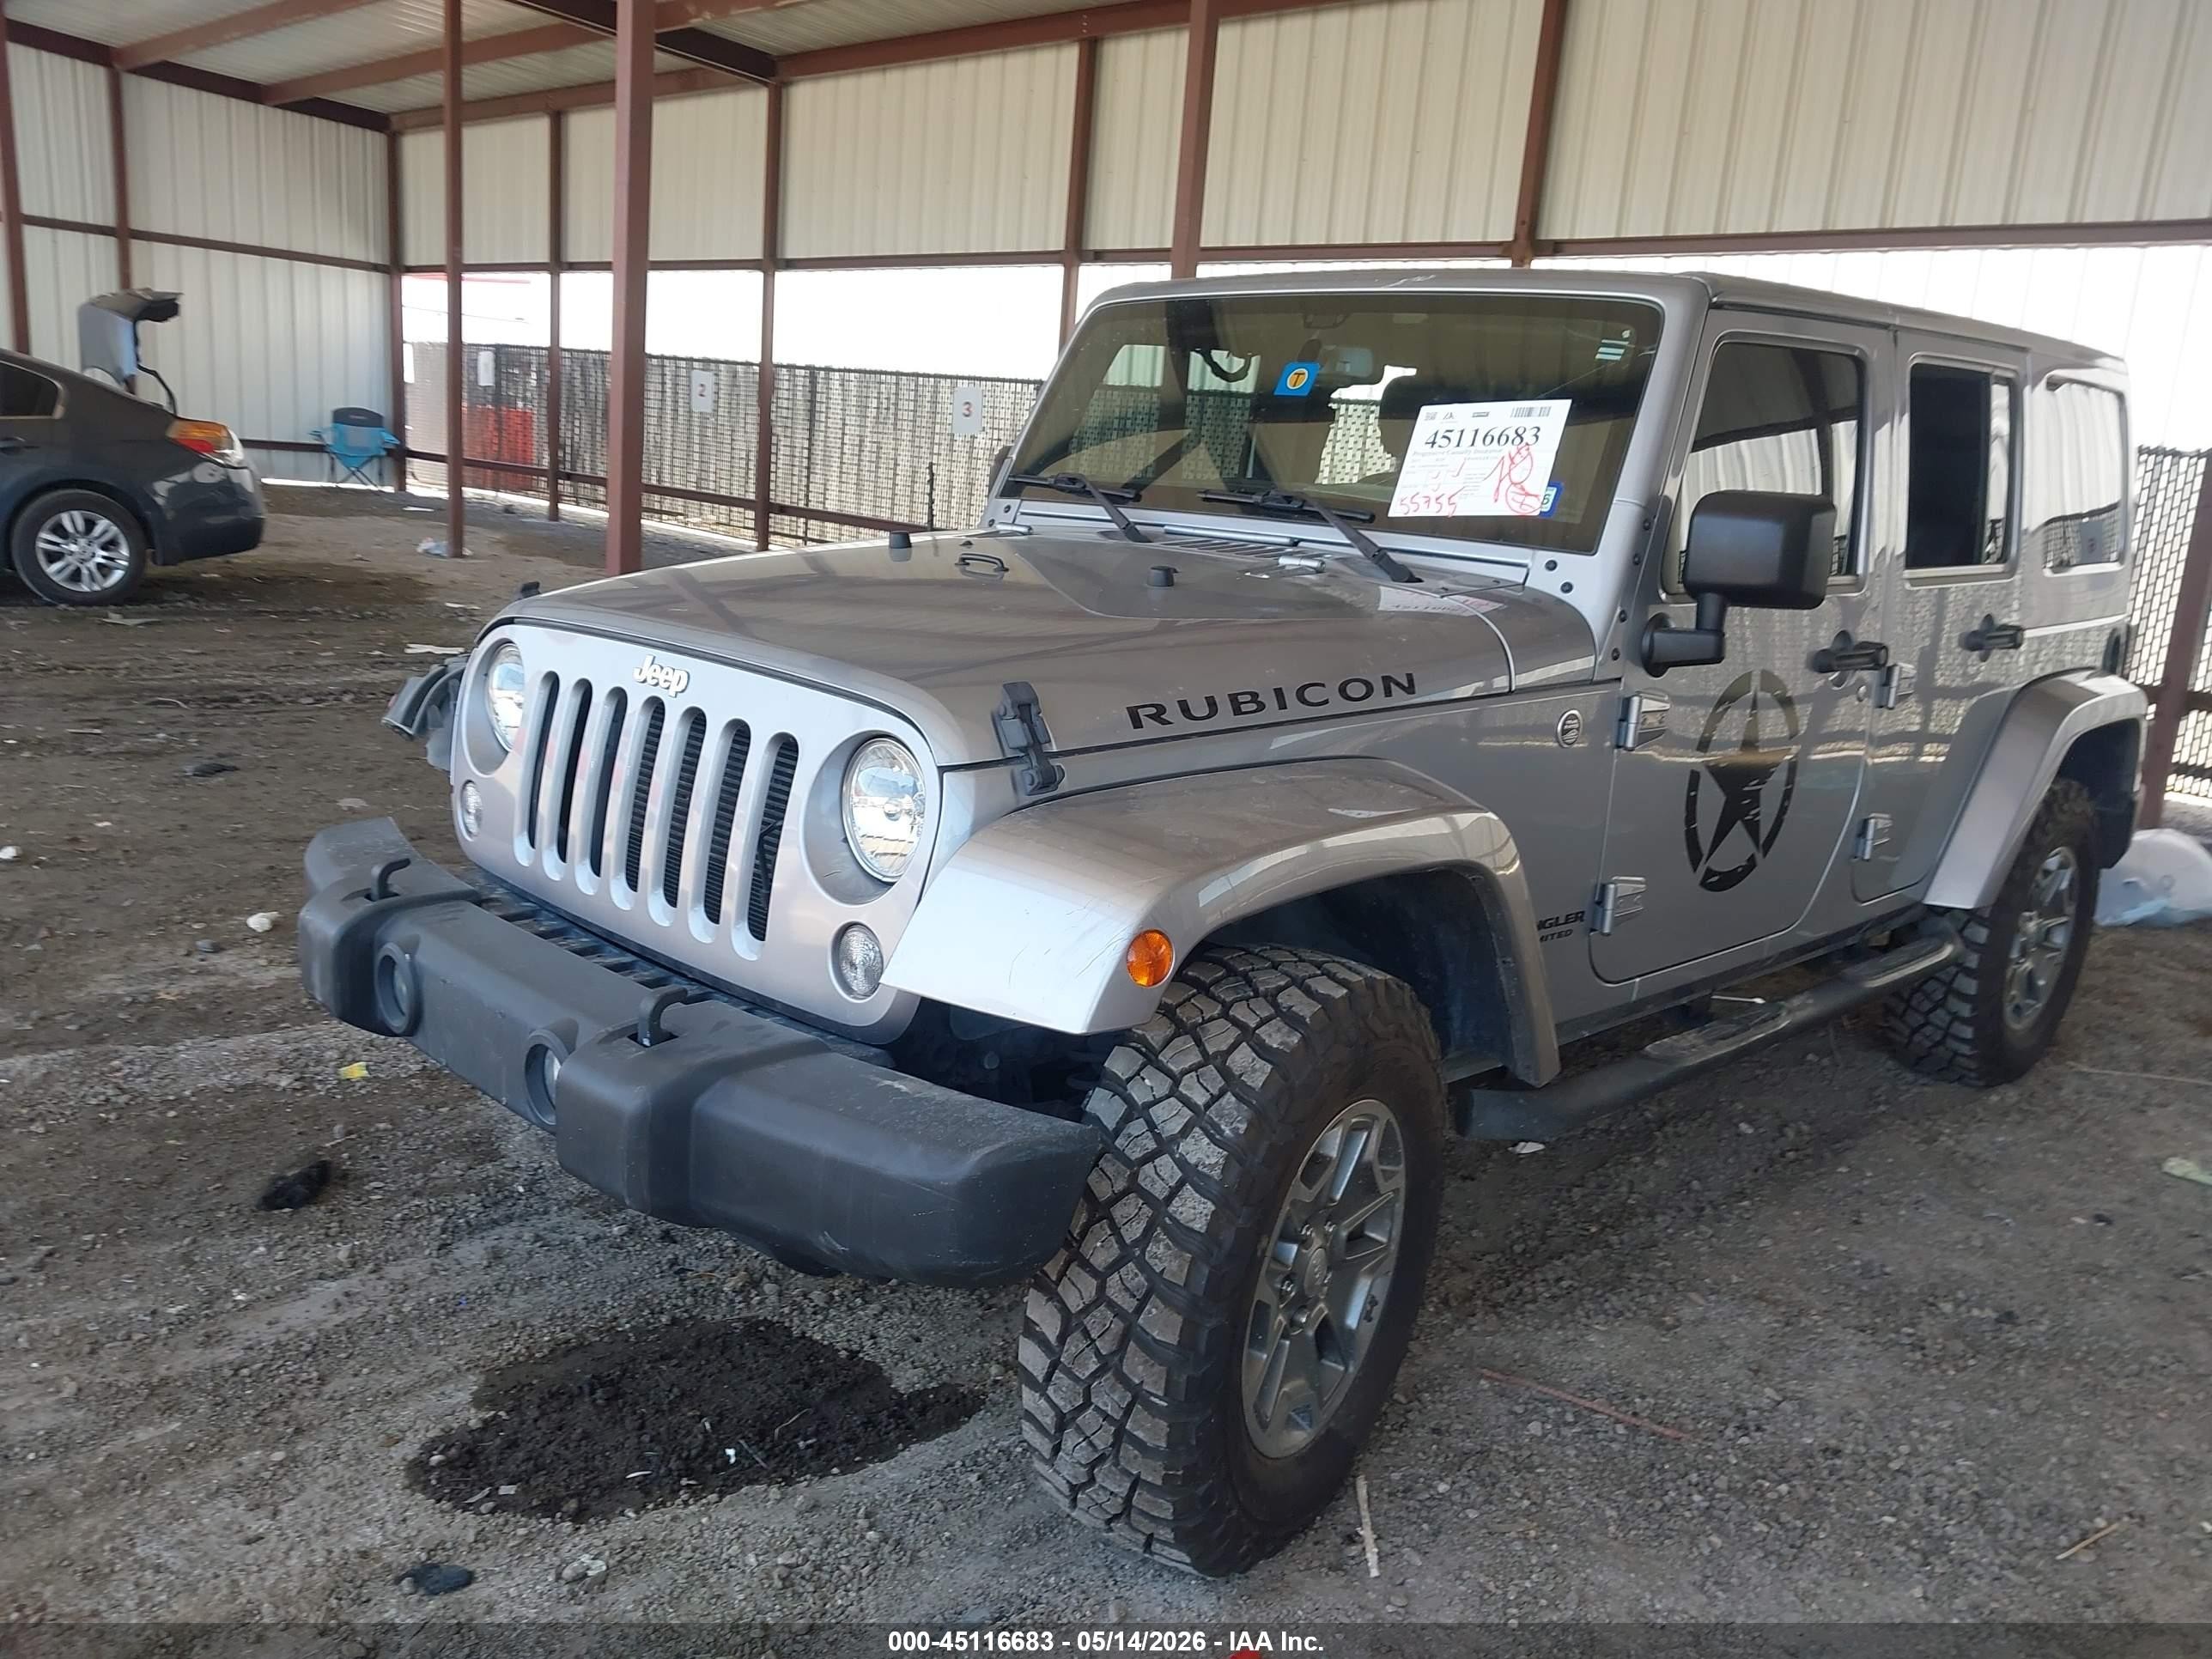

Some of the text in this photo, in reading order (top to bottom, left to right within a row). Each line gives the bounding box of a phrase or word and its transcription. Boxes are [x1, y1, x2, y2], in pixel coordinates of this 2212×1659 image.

[1292, 372, 1306, 387] T
[697, 383, 707, 398] 2
[962, 401, 973, 417] 3
[1425, 426, 1540, 448] 45116683
[633, 654, 690, 698] Jeep
[1126, 672, 1416, 730] RUBICON
